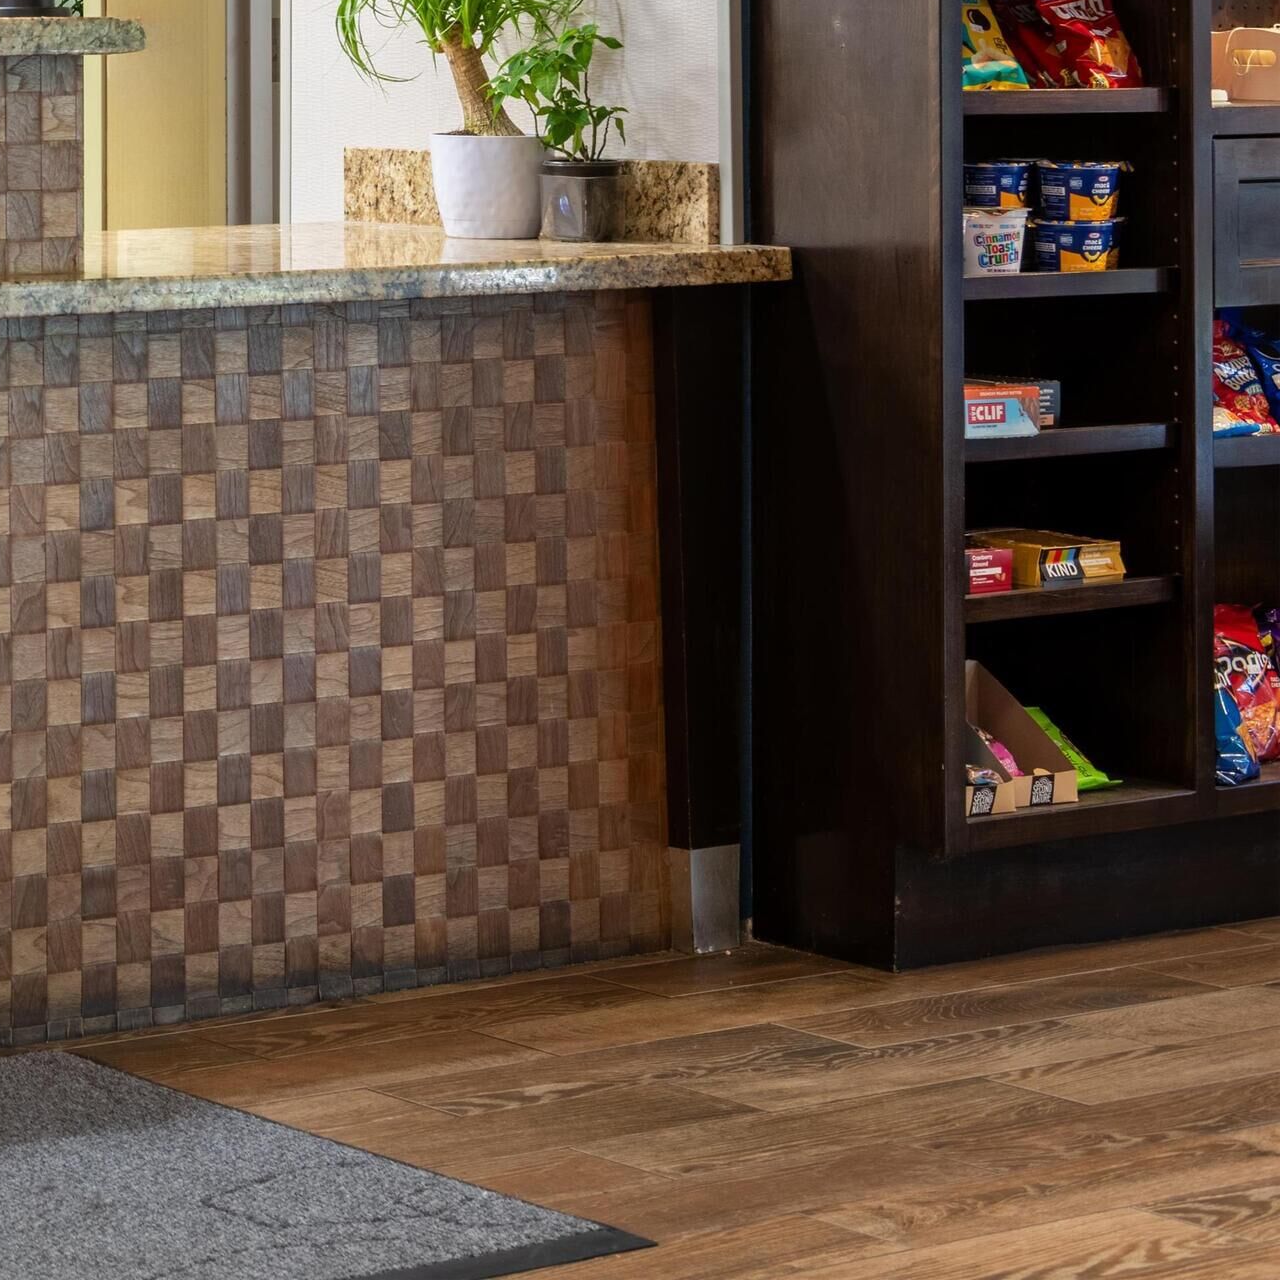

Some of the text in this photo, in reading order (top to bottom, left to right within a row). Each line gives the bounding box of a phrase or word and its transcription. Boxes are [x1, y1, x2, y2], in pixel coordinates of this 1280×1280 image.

[985, 240, 1017, 255] Toast
[978, 251, 1019, 268] Crunch
[976, 405, 1004, 421] CLIF
[1045, 562, 1078, 578] KIND
